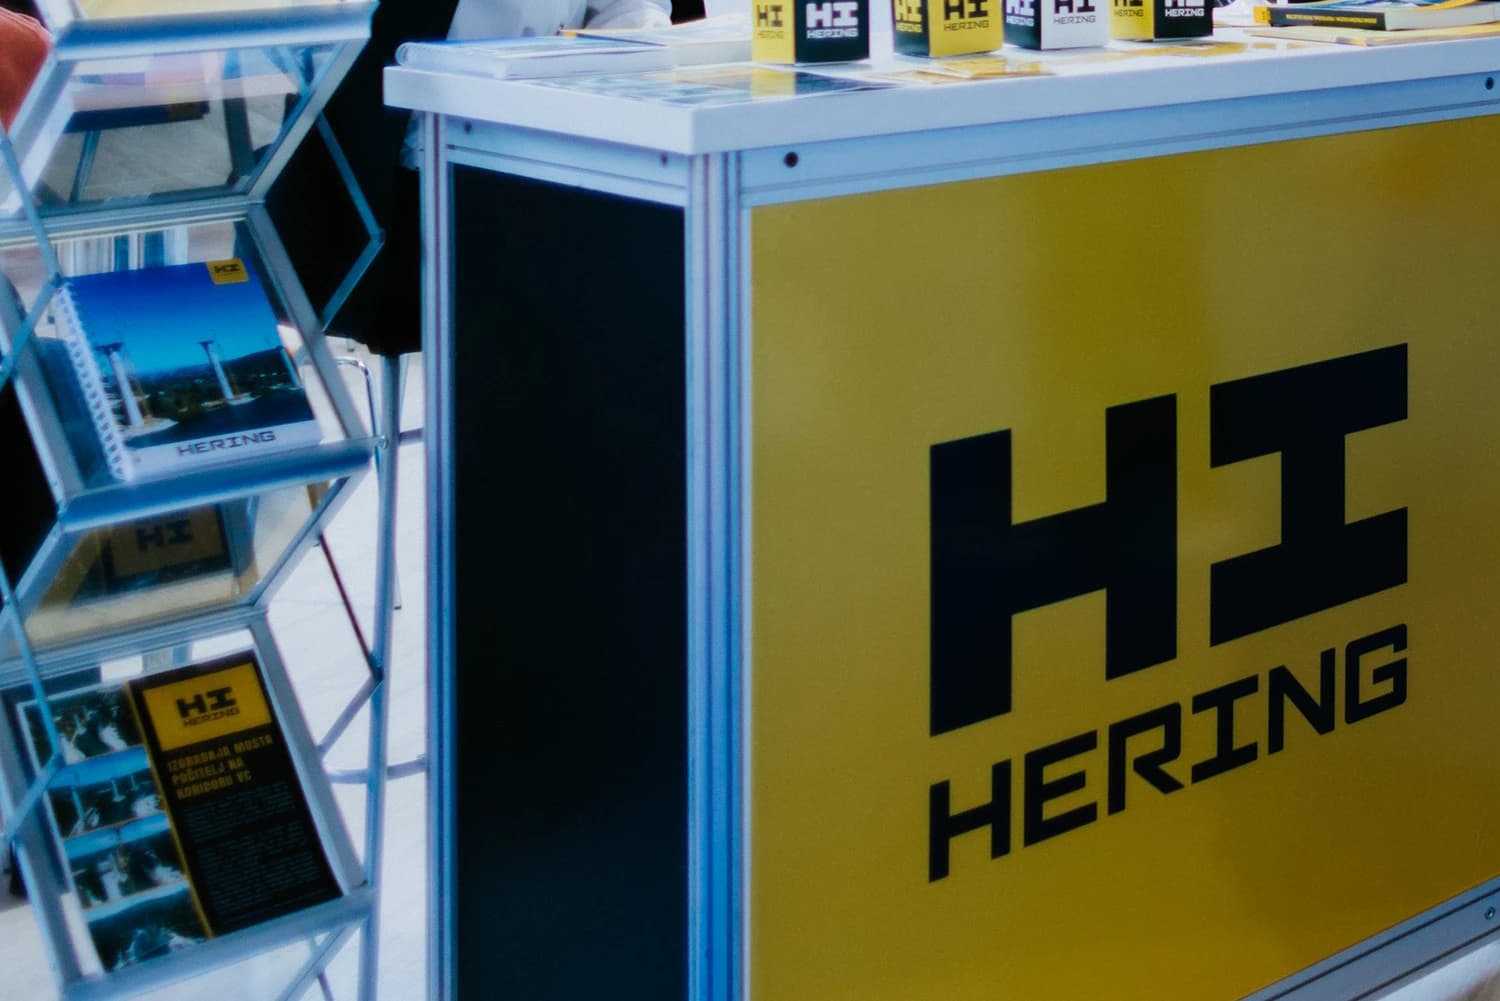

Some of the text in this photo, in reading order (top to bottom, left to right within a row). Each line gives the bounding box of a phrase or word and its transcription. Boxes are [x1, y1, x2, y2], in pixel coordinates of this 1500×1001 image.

[756, 4, 784, 28] HI
[806, 1, 859, 28] HI
[1053, 15, 1097, 25] HERING
[1113, 8, 1144, 18] HERING
[1164, 8, 1205, 18] HERING
[806, 28, 859, 40] HERING
[943, 20, 990, 32] HERING
[175, 430, 278, 457] HERING
[929, 341, 1409, 738] HI
[175, 685, 237, 718] HI
[183, 706, 241, 728] HERING
[929, 623, 1409, 884] HERING
